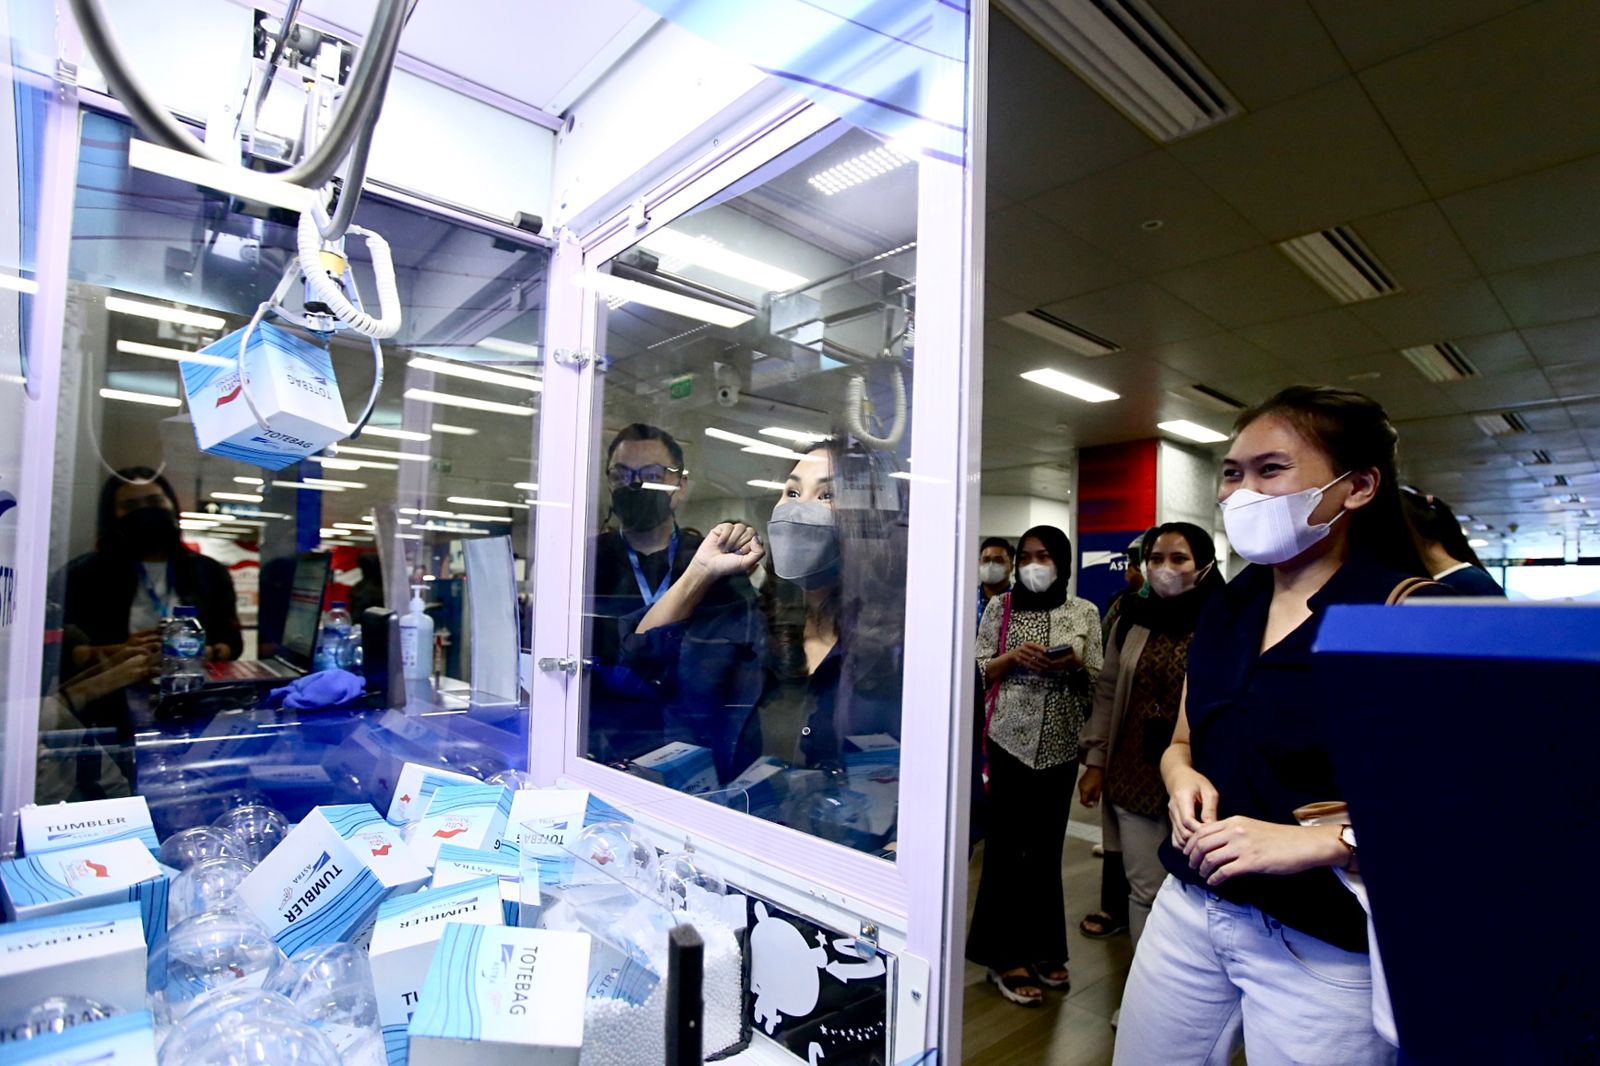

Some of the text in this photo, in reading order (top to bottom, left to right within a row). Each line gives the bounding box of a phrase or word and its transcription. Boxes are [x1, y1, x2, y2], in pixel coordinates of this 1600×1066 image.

[264, 430, 314, 449] TOTEBAG
[1109, 561, 1129, 571] AST
[46, 817, 127, 832] TUMBLER
[292, 863, 312, 884] ASTRA
[283, 864, 343, 923] TUMBLER
[509, 946, 538, 1016] TOTEBAG
[591, 966, 621, 999] STRA
